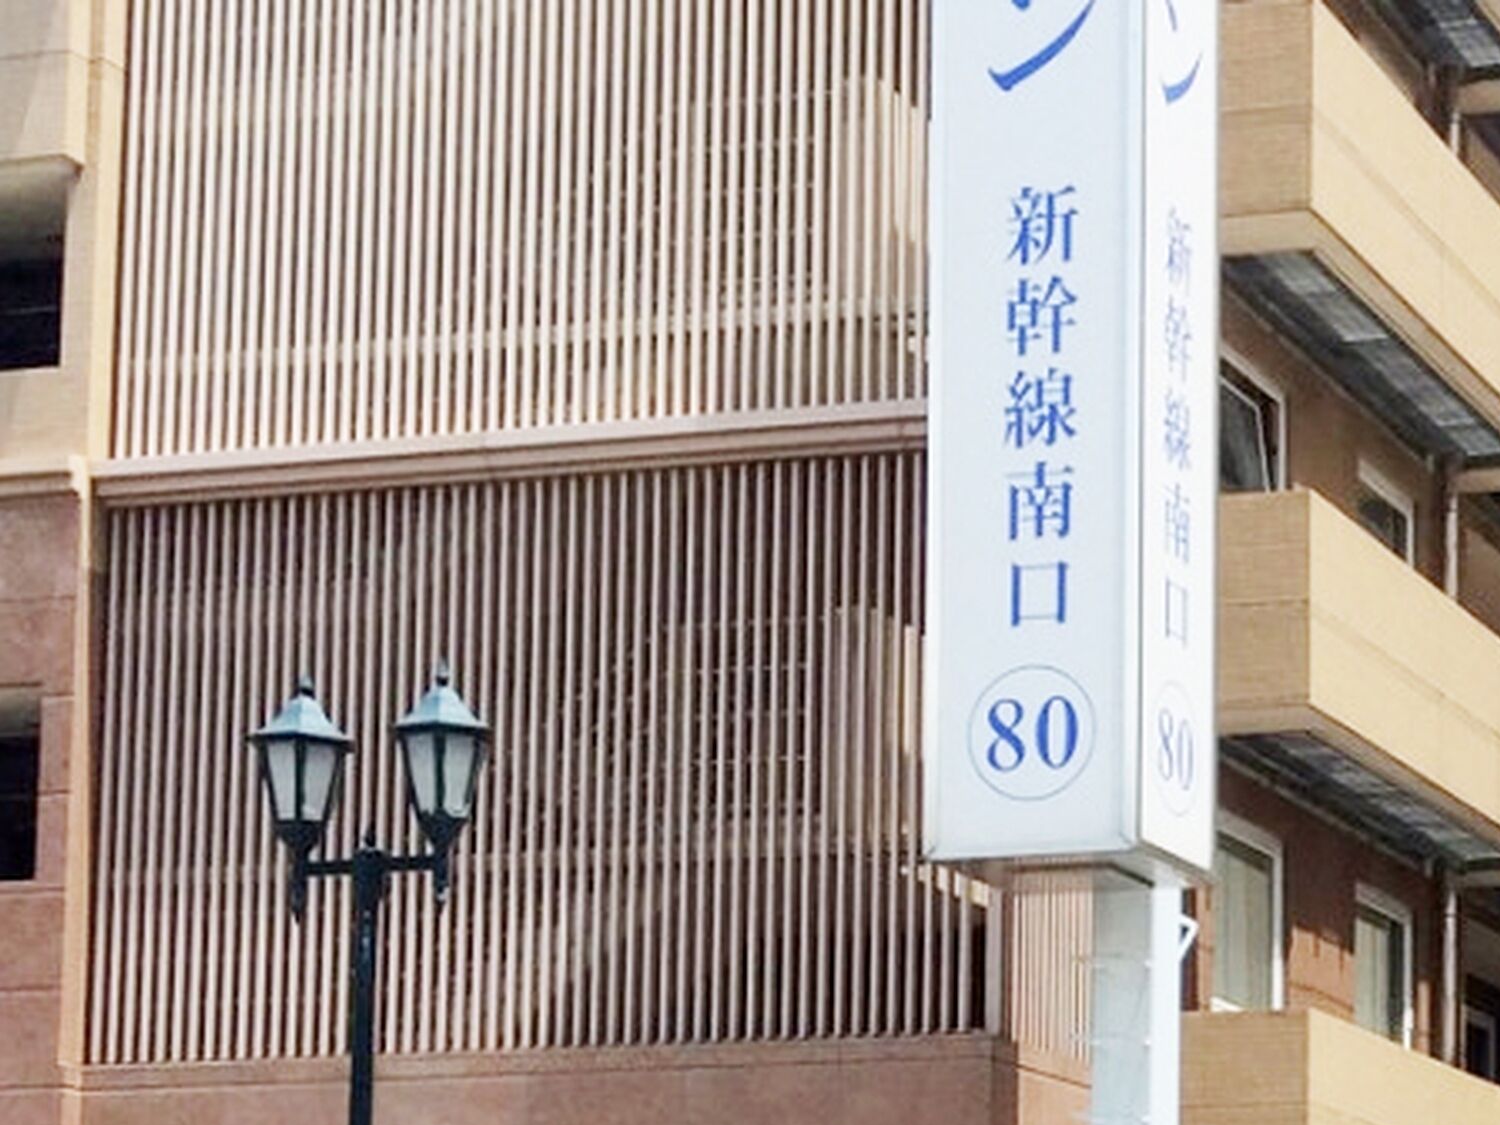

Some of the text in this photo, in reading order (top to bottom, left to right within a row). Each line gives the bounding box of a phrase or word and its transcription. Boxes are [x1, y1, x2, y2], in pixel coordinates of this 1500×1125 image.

[1003, 184, 1079, 628] 新幹線南口
[1164, 206, 1193, 647] 新幹線南口
[986, 695, 1079, 772] 80
[1157, 708, 1195, 791] 80
